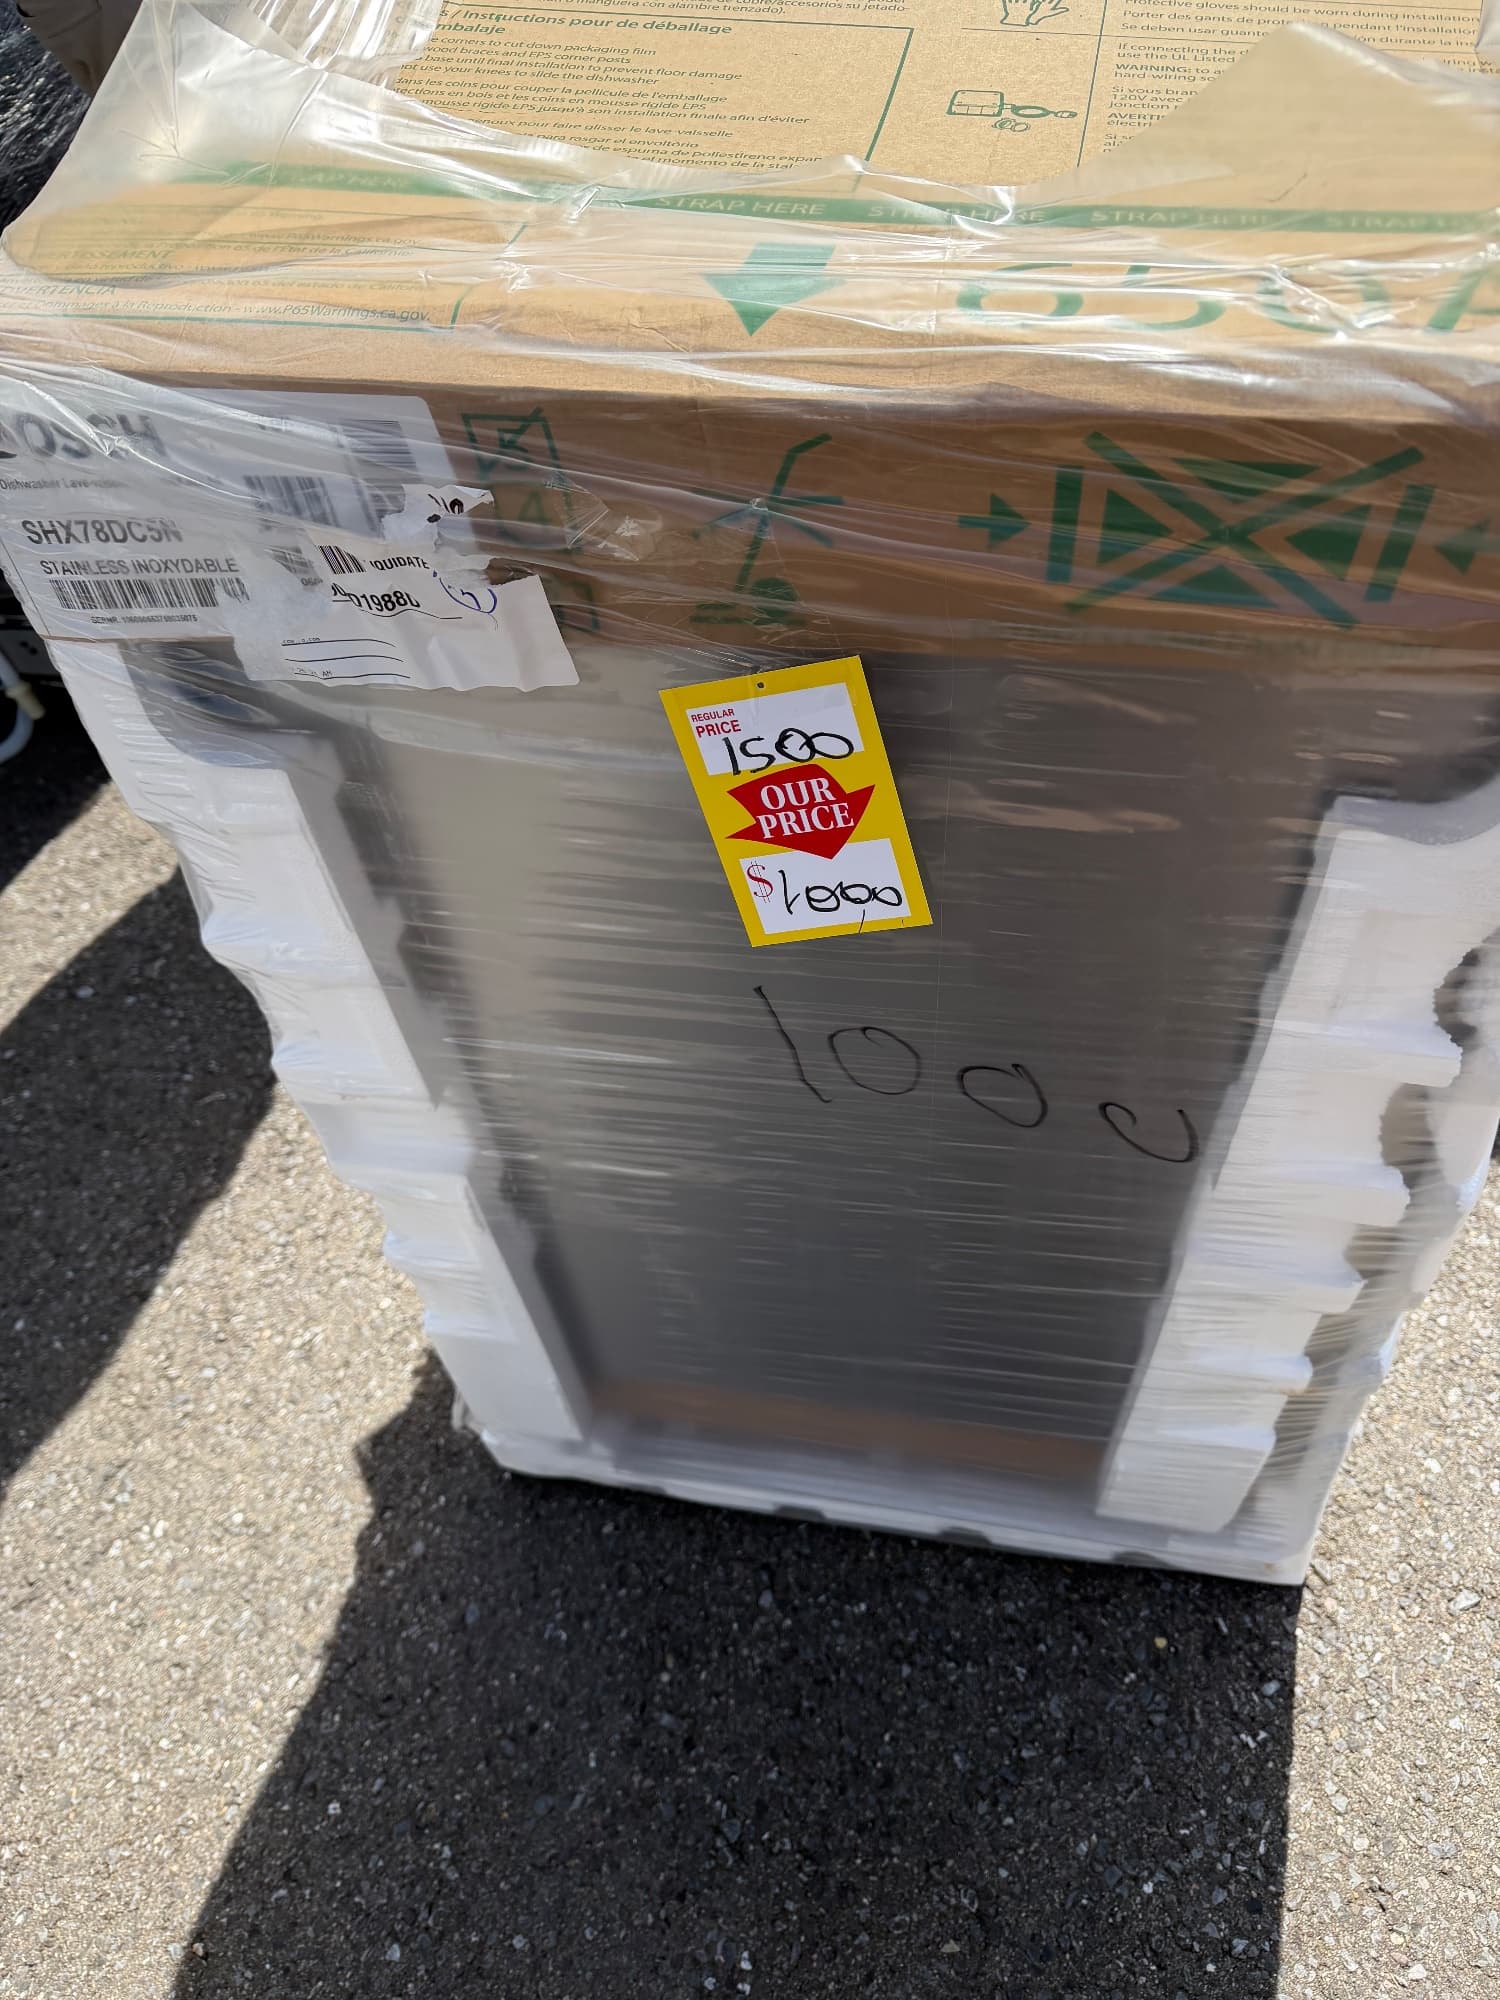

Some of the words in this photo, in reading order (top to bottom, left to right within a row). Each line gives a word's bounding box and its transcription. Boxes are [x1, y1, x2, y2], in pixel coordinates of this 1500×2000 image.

[1122, 9, 1166, 20] Porter
[1167, 11, 1192, 21] des
[1194, 14, 1233, 25] gants
[1235, 15, 1255, 24] de
[1332, 21, 1393, 33] pendant
[1194, 1, 1241, 12] gloves
[1242, 4, 1291, 15] should
[1292, 6, 1312, 15] be
[1313, 9, 1350, 17] worn
[1352, 9, 1400, 21] during
[434, 22, 507, 35] mbalaje
[463, 9, 567, 26] Instructions
[567, 17, 613, 29] pour
[616, 19, 639, 30] de
[642, 20, 733, 36] déballage
[1119, 22, 1138, 31] Se
[1140, 24, 1186, 34] deben
[1187, 26, 1219, 36] usar
[1220, 28, 1272, 38] guante
[1378, 35, 1437, 46] durante
[1438, 37, 1453, 47] la
[438, 37, 487, 47] corners
[488, 39, 501, 48] to
[503, 40, 525, 49] cut
[526, 41, 562, 51] down
[563, 45, 630, 57] packaging
[631, 47, 657, 56] film
[459, 47, 500, 56] braces
[501, 49, 528, 58] and
[528, 51, 553, 60] EPS
[553, 53, 596, 63] corner
[597, 55, 632, 65] posts
[1118, 42, 1130, 51] If
[1129, 43, 1210, 56] connecting
[1213, 47, 1237, 56] the
[424, 54, 455, 64] base
[455, 56, 486, 66] until
[486, 58, 515, 67] final
[515, 60, 586, 72] installation
[586, 65, 601, 73] to
[602, 66, 655, 76] prevent
[655, 68, 688, 78] floor
[688, 70, 743, 81] damage
[1116, 52, 1142, 60] use
[1143, 52, 1169, 61] the
[1170, 53, 1192, 62] UL
[1192, 54, 1236, 64] Listed
[420, 65, 442, 73] use
[442, 66, 472, 76] your
[473, 67, 513, 77] knees
[513, 70, 529, 78] to
[528, 71, 561, 80] slide
[562, 72, 584, 81] the
[585, 73, 661, 86] dishwasher
[1115, 63, 1193, 74] WARNING:
[1195, 67, 1211, 75] to
[424, 78, 443, 87] les
[444, 80, 479, 89] coins
[478, 83, 515, 92] pour
[513, 85, 561, 95] couper
[560, 86, 574, 95] la
[573, 88, 631, 99] pellicule
[631, 91, 650, 99] de
[651, 92, 729, 104] l'emballage
[447, 90, 464, 98] en
[465, 90, 493, 99] bois
[498, 93, 512, 101] et
[511, 93, 530, 102] les
[531, 95, 568, 105] coins
[567, 97, 585, 105] en
[586, 98, 639, 108] mousse
[640, 100, 681, 111] rigide
[681, 102, 707, 111] EPS
[1111, 86, 1125, 94] Si
[1127, 87, 1162, 96] vous
[1111, 93, 1148, 103] 120V
[1149, 95, 1185, 104] avec
[421, 99, 471, 108] mousse
[471, 100, 512, 111] rigide
[511, 103, 537, 112] EPS
[534, 105, 586, 116] jusqu'à
[586, 108, 612, 116] son
[612, 108, 688, 120] installation
[688, 112, 728, 122] finale
[728, 114, 756, 122] afin
[756, 115, 811, 125] d'éviter
[1108, 100, 1171, 111] jonction
[516, 120, 552, 130] pour
[551, 121, 583, 131] faire
[583, 123, 628, 134] glisser
[568, 136, 612, 146] rasgar
[668, 149, 690, 158] de
[690, 150, 777, 162] poliestireno
[729, 160, 752, 169] de
[654, 196, 746, 212] STRAP
[751, 200, 829, 216] HERE
[20, 516, 186, 546] SHX78DC5N
[38, 558, 131, 577] STAINLESS
[131, 556, 241, 575] INOXYDABLE
[690, 707, 736, 723] REGULAR
[694, 719, 742, 738] PRICE
[721, 727, 855, 776] 1500
[759, 776, 837, 811] OUR
[756, 802, 855, 840] PRICE
